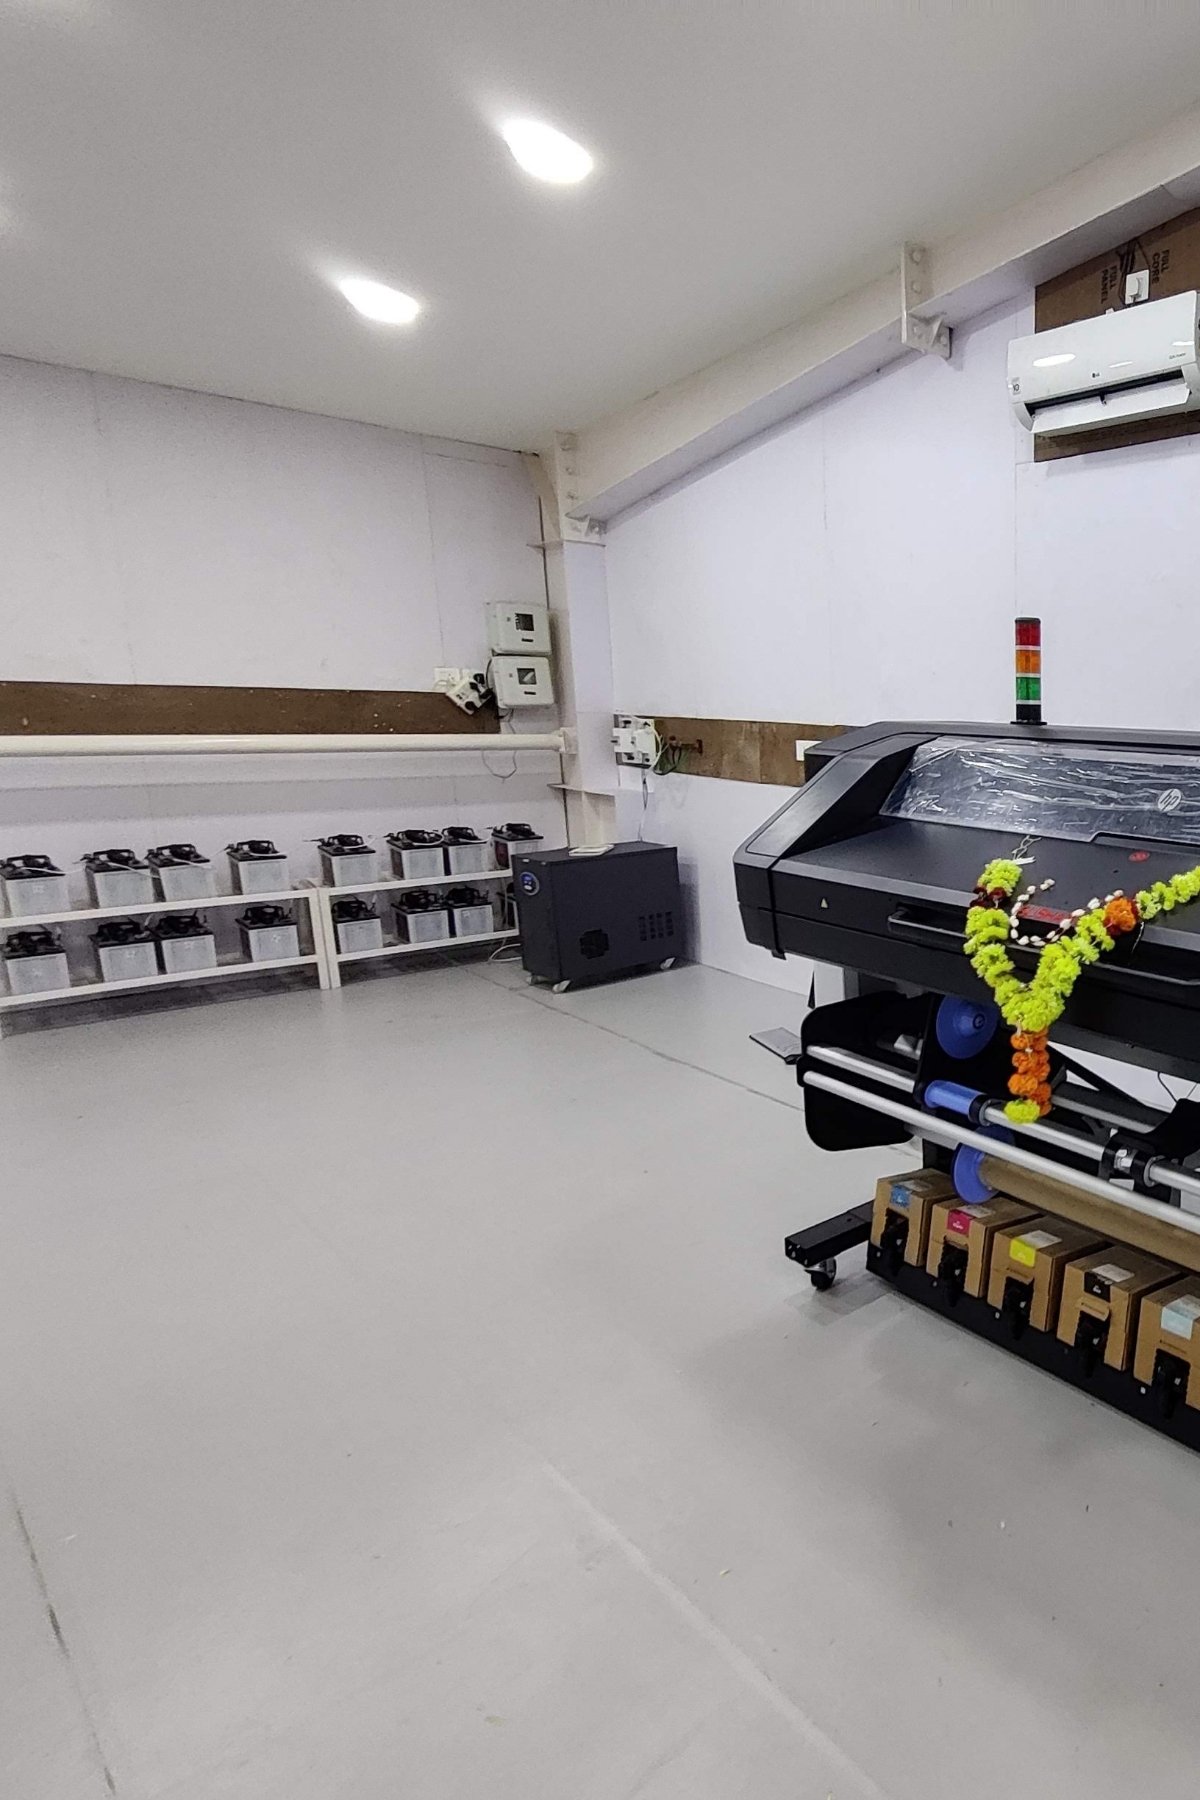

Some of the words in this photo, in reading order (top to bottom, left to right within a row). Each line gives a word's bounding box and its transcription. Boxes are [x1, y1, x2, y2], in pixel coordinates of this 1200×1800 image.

[1152, 252, 1160, 284] CORE
[1161, 249, 1170, 273] FULL
[1101, 268, 1109, 304] PANEL
[1109, 265, 1118, 290] FULL
[1158, 788, 1182, 812] hp
